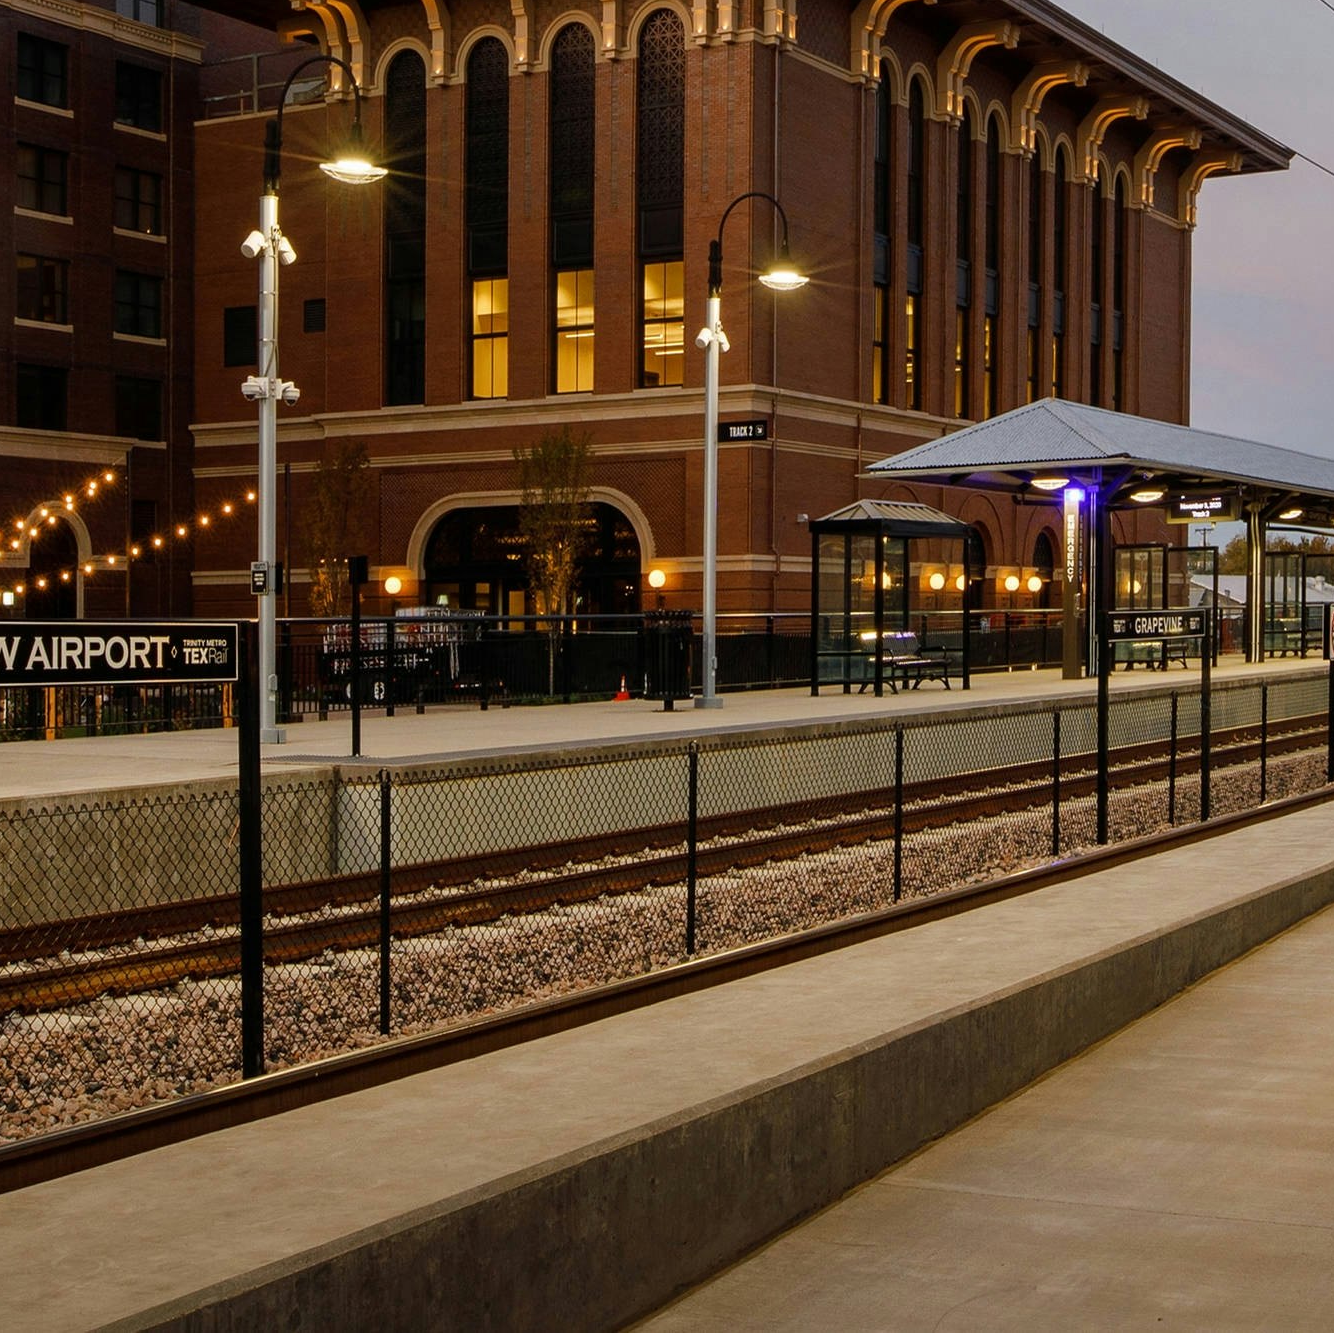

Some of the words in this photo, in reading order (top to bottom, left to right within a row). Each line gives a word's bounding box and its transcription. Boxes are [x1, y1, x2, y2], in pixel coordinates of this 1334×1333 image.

[729, 426, 747, 437] TRACK
[748, 425, 753, 436] 2
[1067, 514, 1075, 583] EMERGENCY
[1134, 616, 1183, 634] GRAPEVINE
[183, 639, 205, 647] TRINITY
[25, 635, 170, 670] AIRPORT
[183, 647, 227, 664] TEXRail
